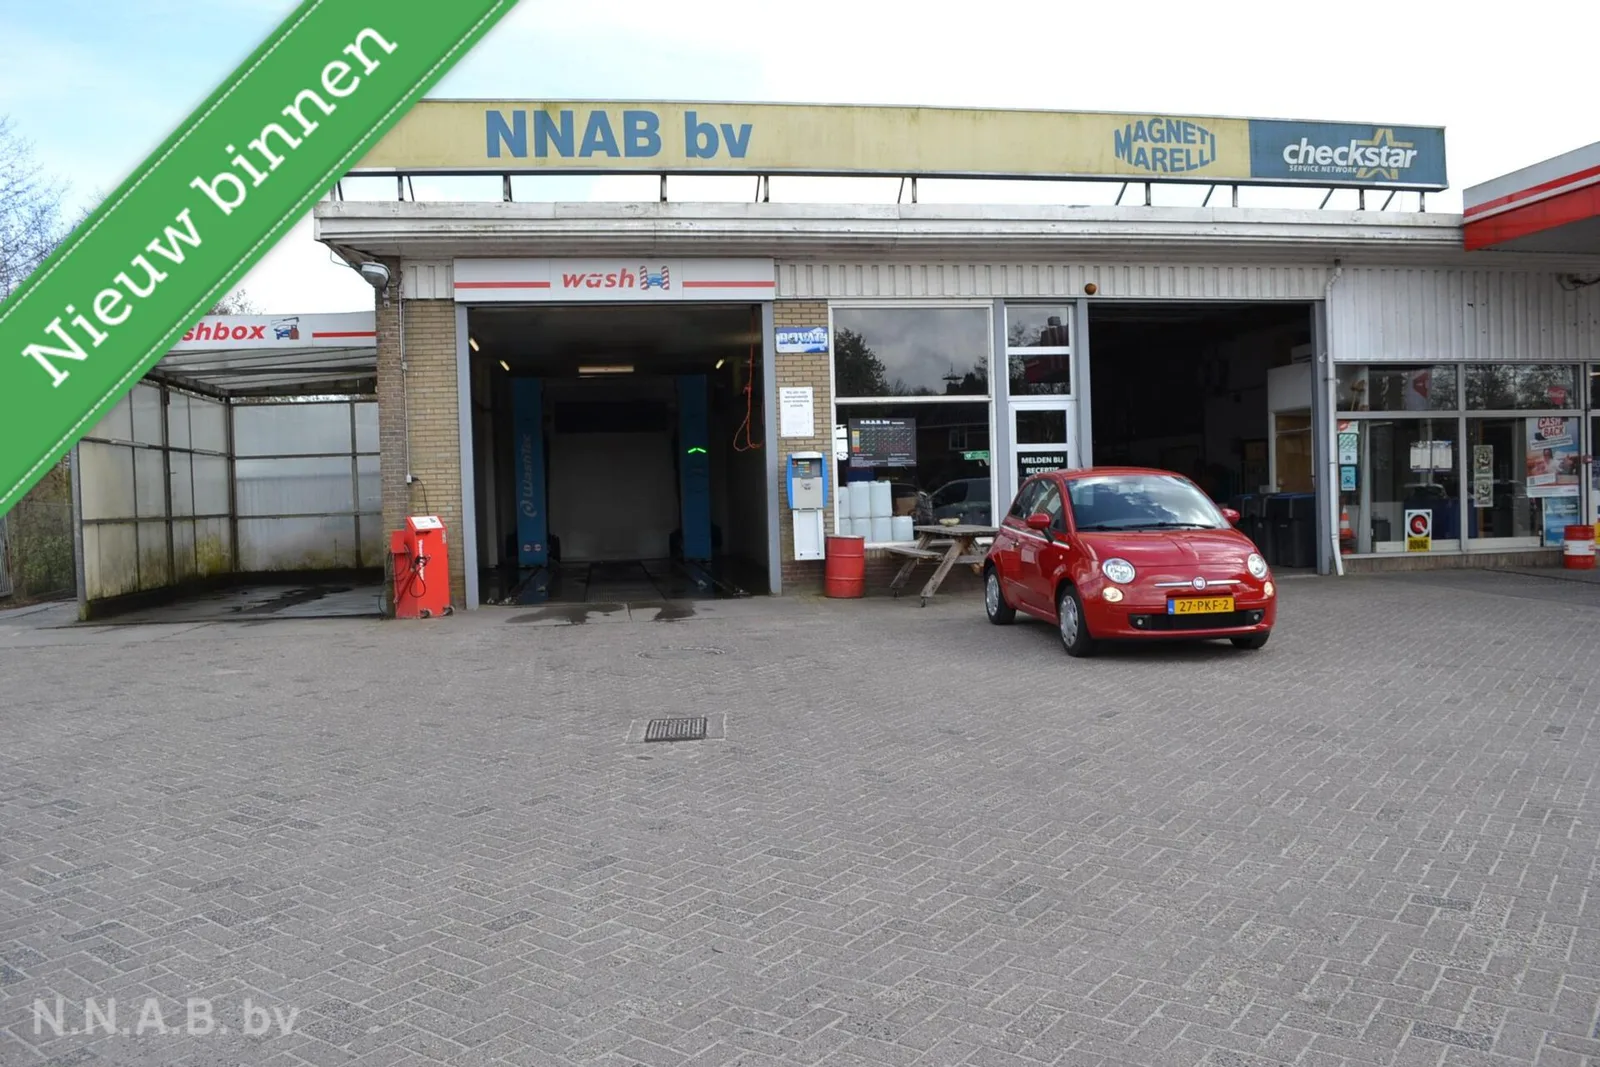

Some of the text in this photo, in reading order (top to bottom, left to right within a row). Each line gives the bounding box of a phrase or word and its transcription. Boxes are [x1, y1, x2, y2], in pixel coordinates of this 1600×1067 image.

[485, 109, 753, 159] NNAB bv
[1114, 118, 1216, 157] MAGNETI
[1114, 136, 1216, 172] MARELLI
[1283, 137, 1418, 168] checkstar
[1289, 164, 1357, 174] SERVICE NETWORK
[562, 268, 635, 289] wash
[182, 322, 266, 341] shbox
[1020, 456, 1052, 464] MELDEN
[1179, 600, 1229, 612] 27-PKF-2
